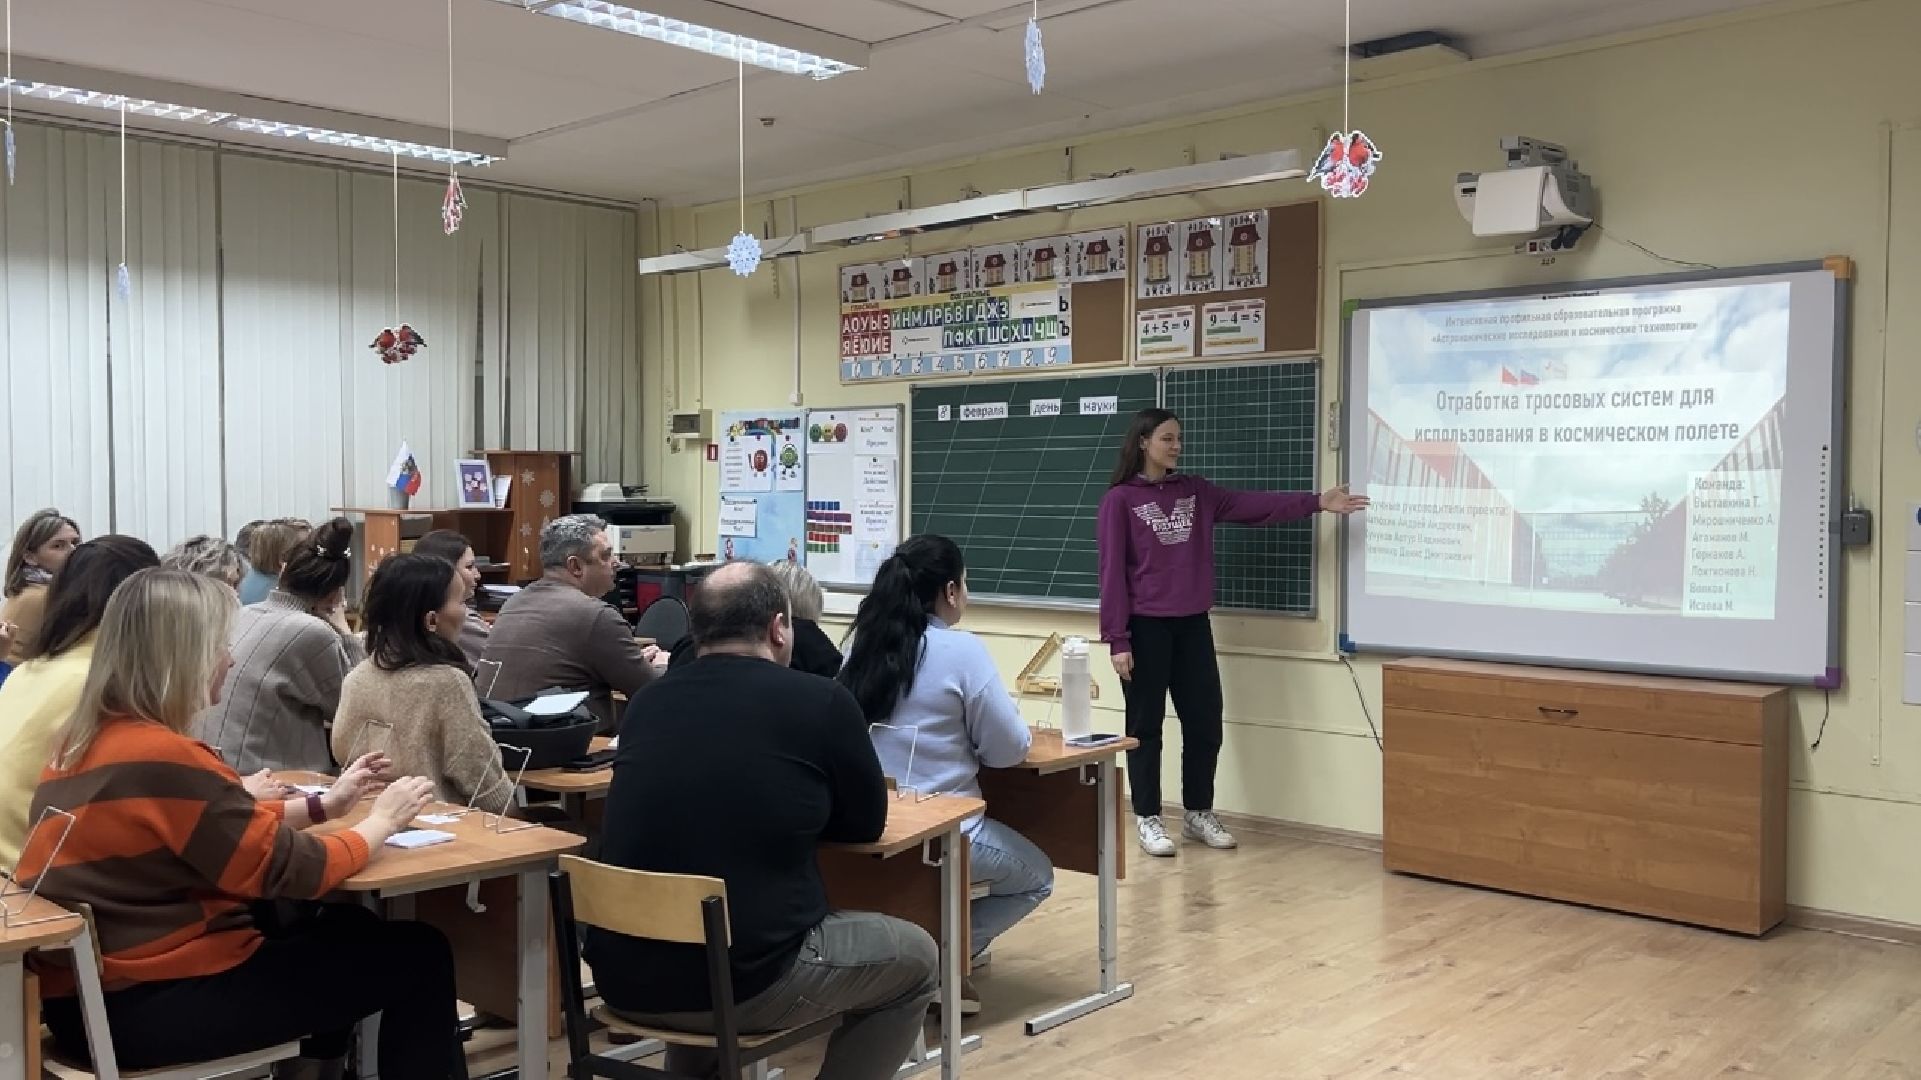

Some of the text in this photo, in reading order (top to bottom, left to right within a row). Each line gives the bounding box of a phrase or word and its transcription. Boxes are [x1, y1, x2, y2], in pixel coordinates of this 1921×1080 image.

[1445, 304, 1682, 327] Интенсивная профильная образовательная программа
[1509, 328, 1570, 341] исследования
[1571, 328, 1577, 337] и
[1579, 325, 1637, 336] космические
[1436, 388, 1714, 415] Отработка тросовых систем для
[963, 408, 1004, 418] февраля
[1033, 404, 1060, 414] день
[1083, 402, 1116, 413] науки
[1414, 422, 1739, 443] использования в космическом полете
[1694, 477, 1746, 492] Команда:
[1402, 502, 1464, 514] руководители
[1690, 582, 1723, 593] Волков
[1689, 598, 1723, 611] Исаева
